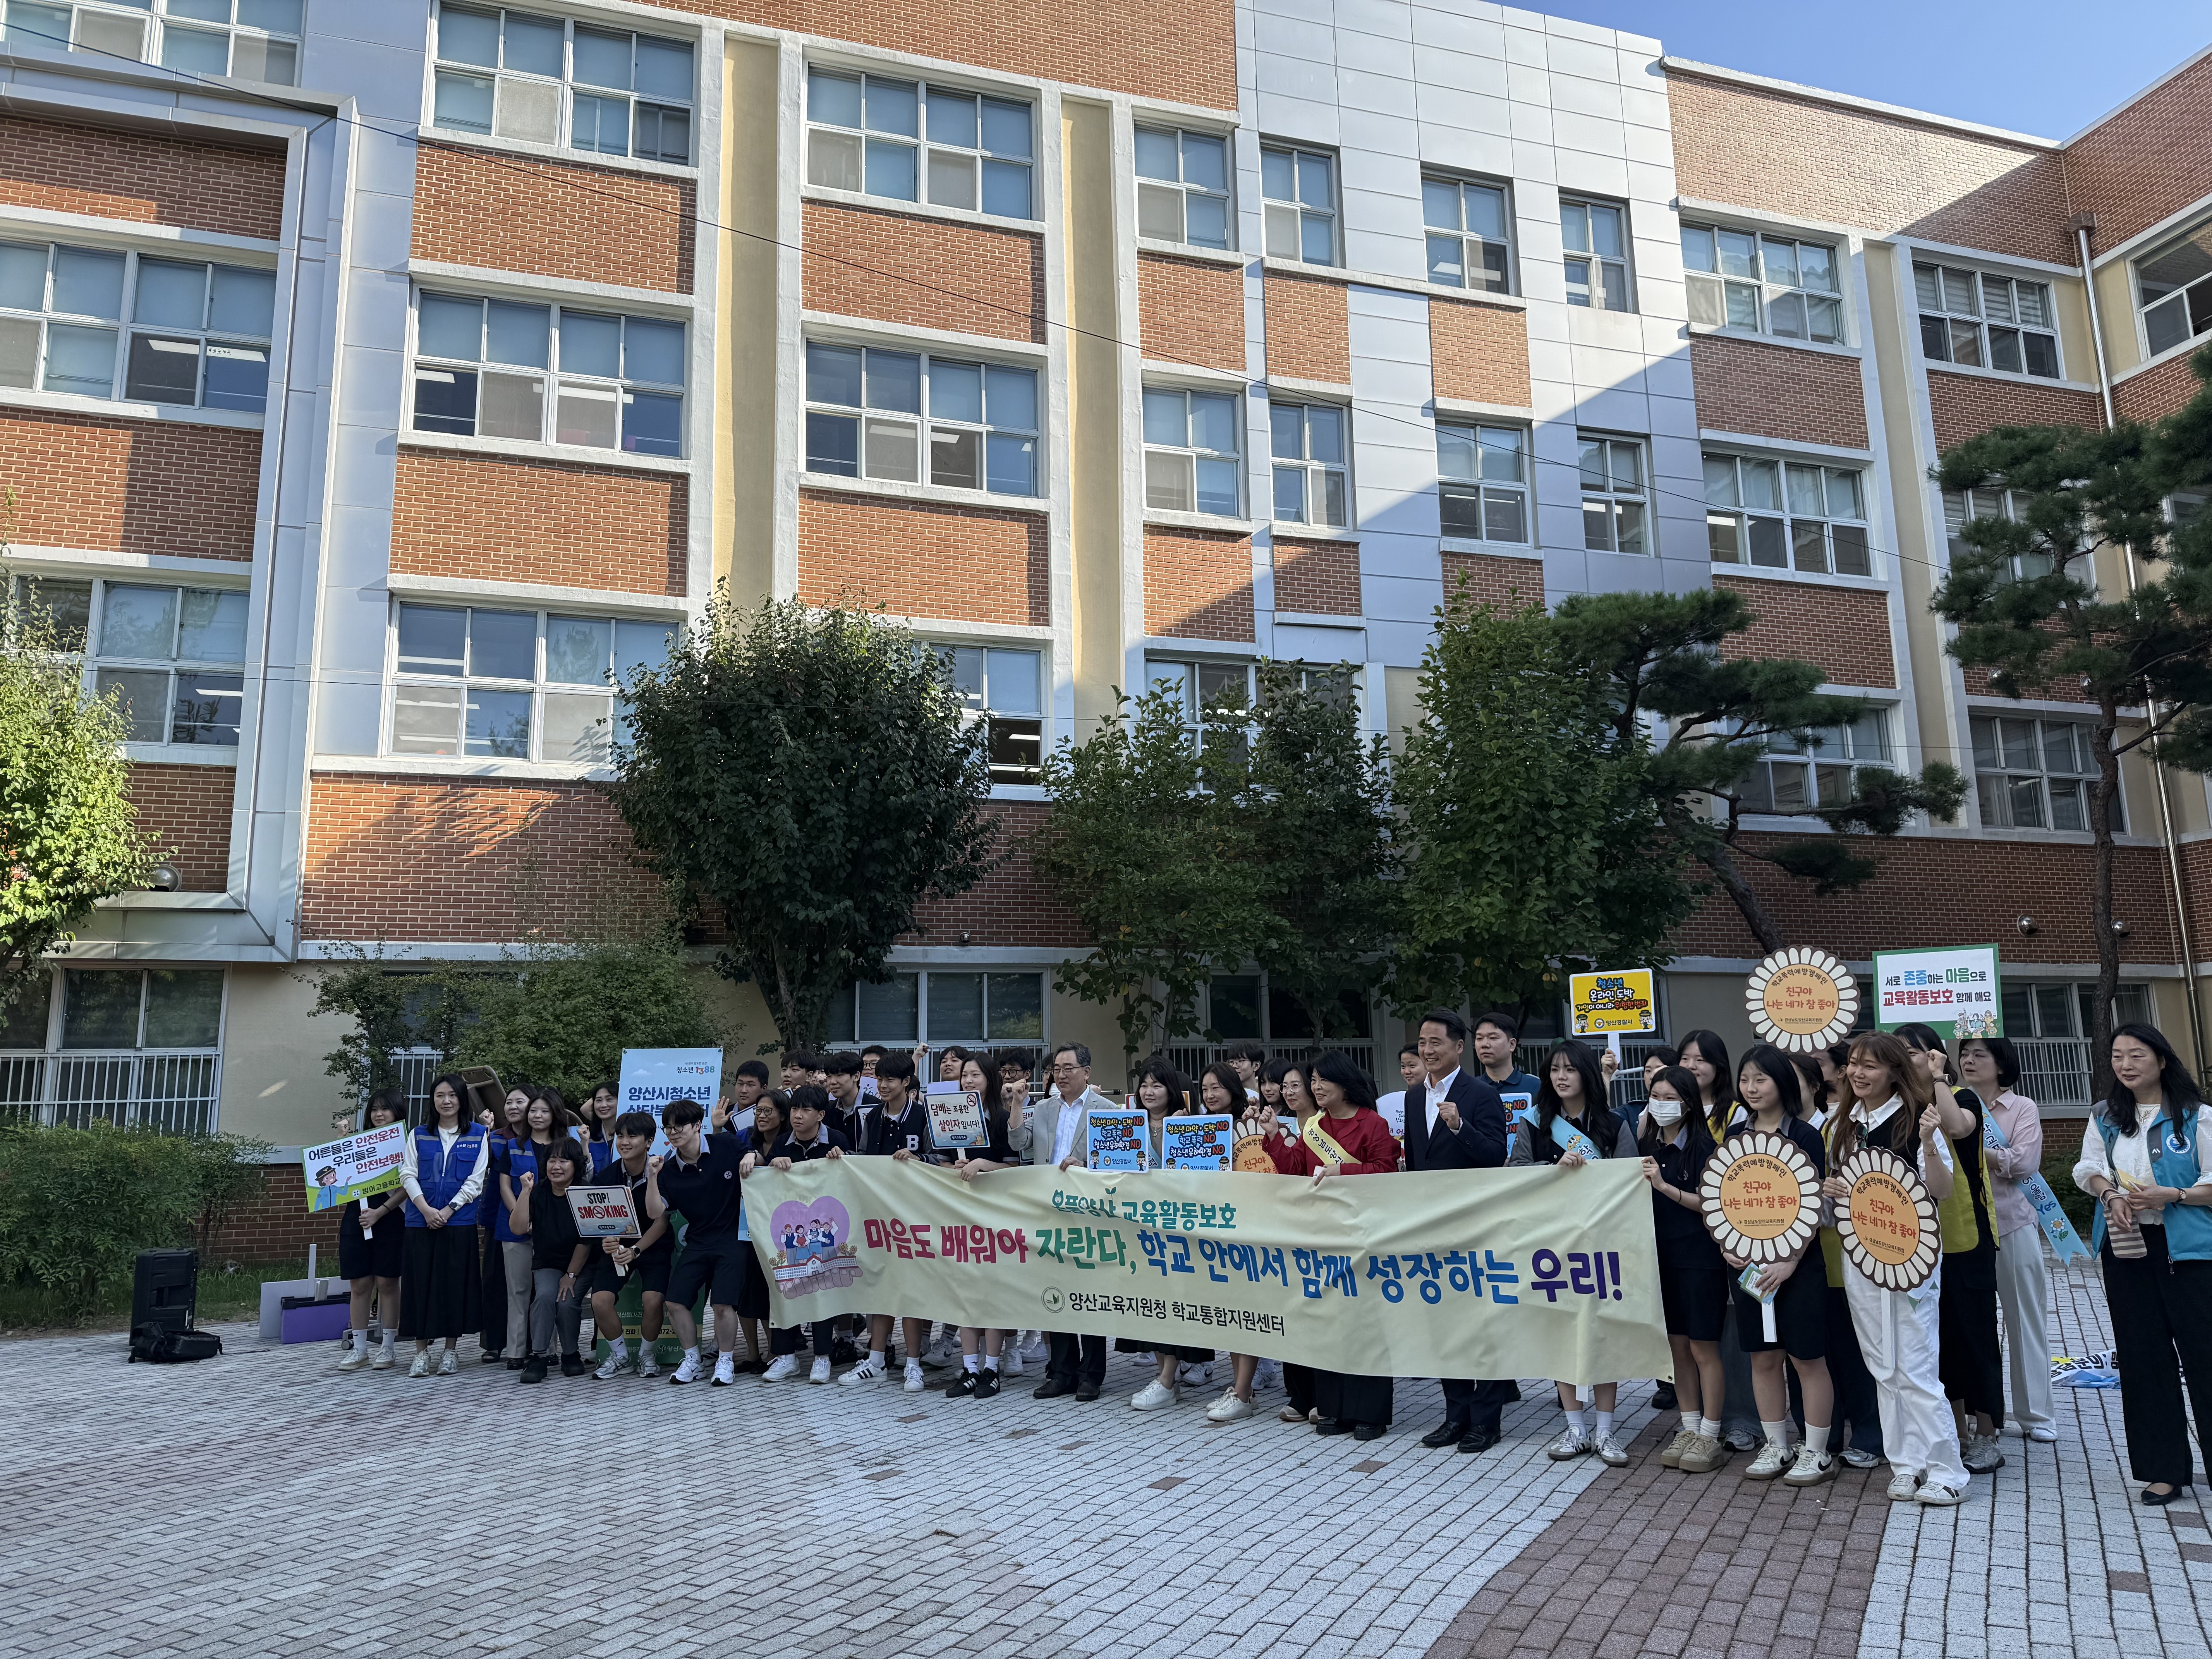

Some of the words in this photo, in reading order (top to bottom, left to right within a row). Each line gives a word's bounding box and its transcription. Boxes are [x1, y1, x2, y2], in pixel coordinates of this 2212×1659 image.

[1886, 976, 1901, 986] 서로
[1904, 970, 1943, 986] 존중하는
[1946, 967, 1987, 983] 마음으로
[1597, 978, 1623, 989] 청소년
[1590, 990, 1614, 1001] 온라인
[1617, 989, 1634, 998] 도박
[1786, 986, 1812, 997] 친구야
[1883, 988, 1954, 1006] 교육활동보호
[1956, 992, 1972, 1003] 함께
[1975, 991, 1991, 1002] 해요
[1767, 1000, 1783, 1010] 나는
[1806, 999, 1815, 1010] 참
[1817, 999, 1836, 1010] 좋아
[696, 1066, 715, 1075] 1388
[629, 1086, 711, 1101] 양산시청소년
[931, 1103, 951, 1116] 담배는
[953, 1104, 969, 1114] 조용한
[1514, 1101, 1526, 1109] NO
[1091, 1118, 1106, 1127] 청소년
[1506, 1113, 1512, 1121] O
[1101, 1128, 1122, 1138] 학교폭력
[1123, 1129, 1133, 1137] NO
[1167, 1125, 1185, 1134] 청소년
[1217, 1122, 1228, 1130] NO
[309, 1140, 353, 1160] 어른들은
[356, 1127, 400, 1148] 안전운전
[906, 1135, 919, 1151] B
[1130, 1140, 1141, 1149] NO
[1179, 1136, 1203, 1145] 학교폭력
[1204, 1134, 1215, 1142] NO
[1212, 1146, 1224, 1154] NO
[333, 1147, 377, 1167] 우리들은
[356, 1152, 404, 1174] 안전보행!
[1244, 1156, 1266, 1170] 친구야
[362, 1178, 400, 1194] 범어고등학교
[1743, 1181, 1771, 1194] 친구야
[587, 1193, 610, 1204] STOP!
[1724, 1197, 1741, 1210] 나는
[1744, 1198, 1763, 1207] 네가
[1765, 1196, 1776, 1208] 참
[1778, 1195, 1797, 1208] 좋아
[1870, 1198, 1894, 1216] 친구야
[2036, 1201, 2057, 1215] Yes
[1121, 1200, 1236, 1231] 교육활동보호
[1853, 1210, 1867, 1225] 나는
[1870, 1216, 1887, 1230] 네가
[1888, 1220, 1898, 1235] 참
[1899, 1223, 1916, 1239] 좋아
[864, 1218, 936, 1260] 마음도
[941, 1225, 1029, 1264] 배워야
[1036, 1226, 1136, 1274] 자란다,
[1137, 1229, 1195, 1276] 학교
[1199, 1238, 1288, 1287] 안에서
[1291, 1247, 1358, 1298] 함께
[1366, 1250, 1519, 1304] 성장하는
[1531, 1249, 1622, 1302] 우리!
[1069, 1292, 1166, 1319] 양산교육지원청
[1171, 1301, 1285, 1336] 학교통합지원센터
